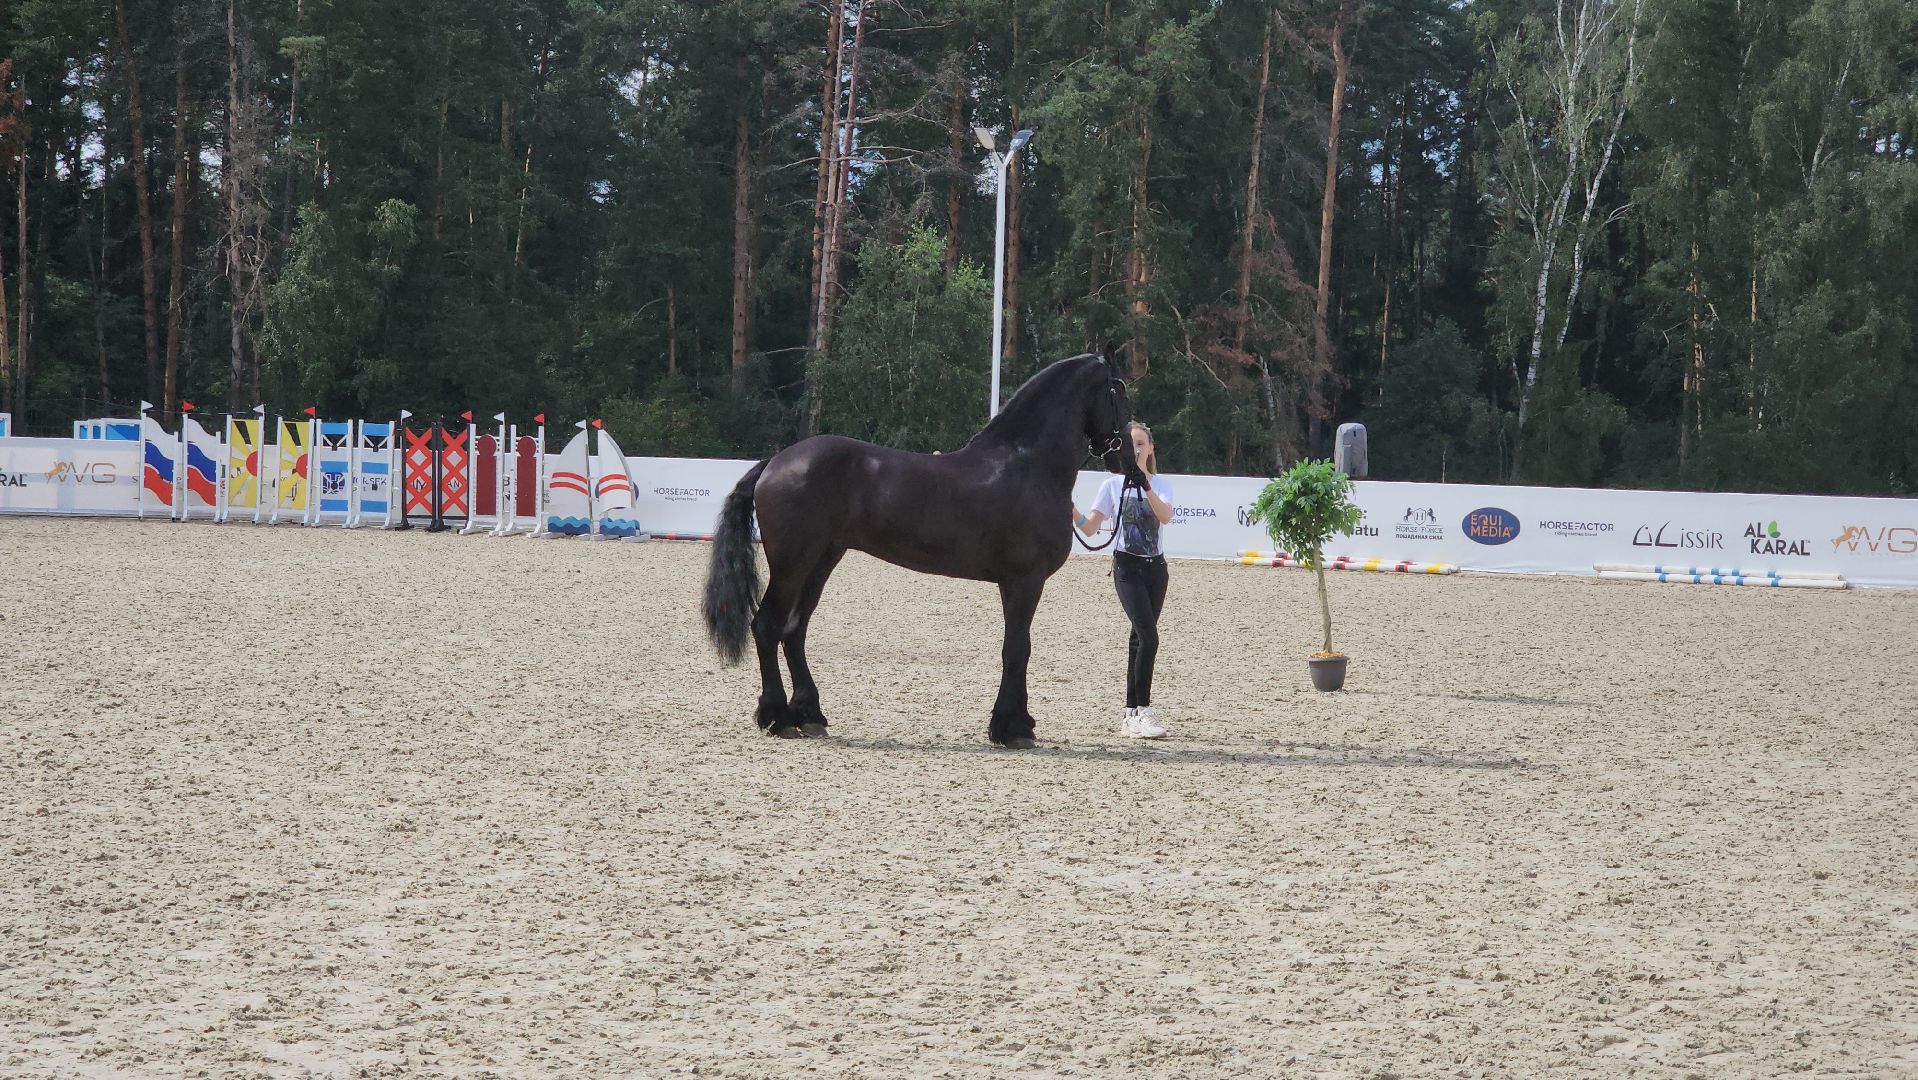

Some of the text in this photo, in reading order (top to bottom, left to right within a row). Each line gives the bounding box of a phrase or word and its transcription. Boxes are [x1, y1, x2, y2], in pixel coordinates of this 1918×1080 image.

[653, 487, 711, 497] HORSEFACTOR
[1470, 514, 1502, 526] EQUI
[1539, 520, 1614, 532] HORSEFACTOR
[1470, 525, 1511, 538] MEDIA
[1743, 522, 1766, 538] AL
[1750, 538, 1811, 556] KARAL
